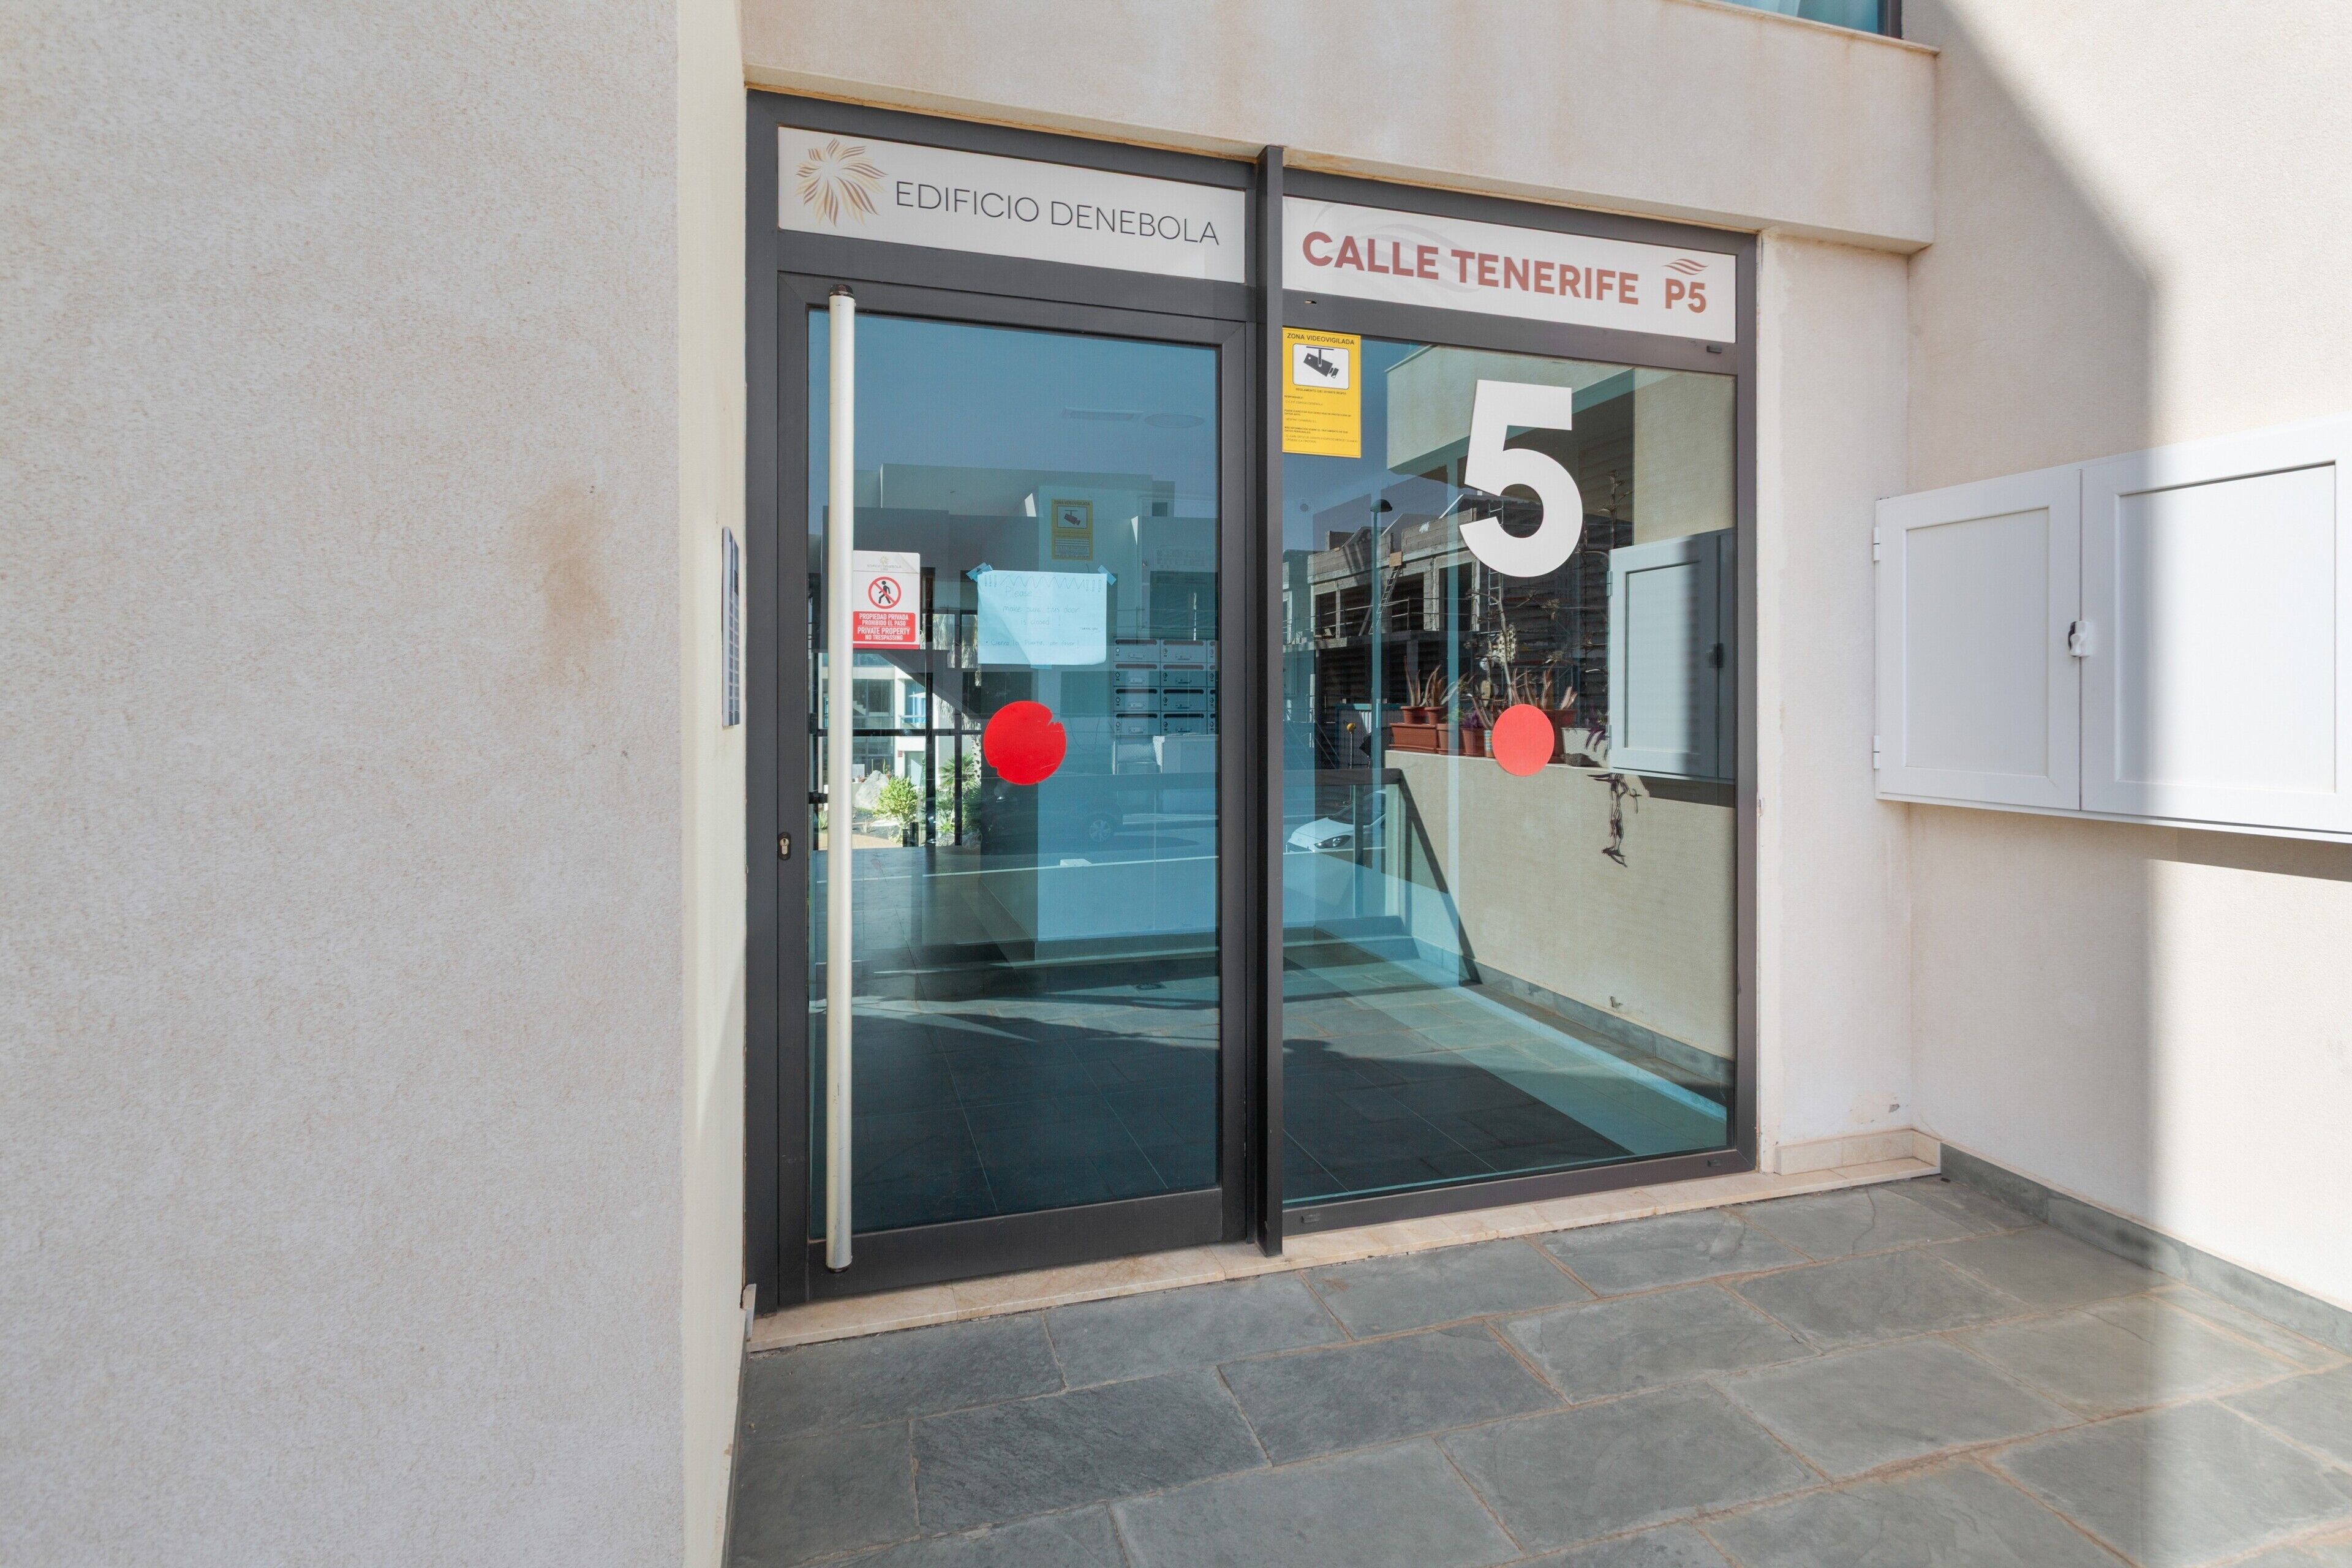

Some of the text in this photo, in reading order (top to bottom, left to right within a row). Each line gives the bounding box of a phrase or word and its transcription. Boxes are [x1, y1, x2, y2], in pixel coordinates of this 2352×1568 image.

[896, 181, 1219, 246] EDIFICIO DENEBOLA
[1303, 231, 1707, 314] CALLE TENERIFE P5
[1306, 335, 1355, 345] VIDEOVIGILADA
[1460, 380, 1583, 577] 5
[1005, 586, 1033, 598] Please
[881, 627, 911, 636] PROPERTY
